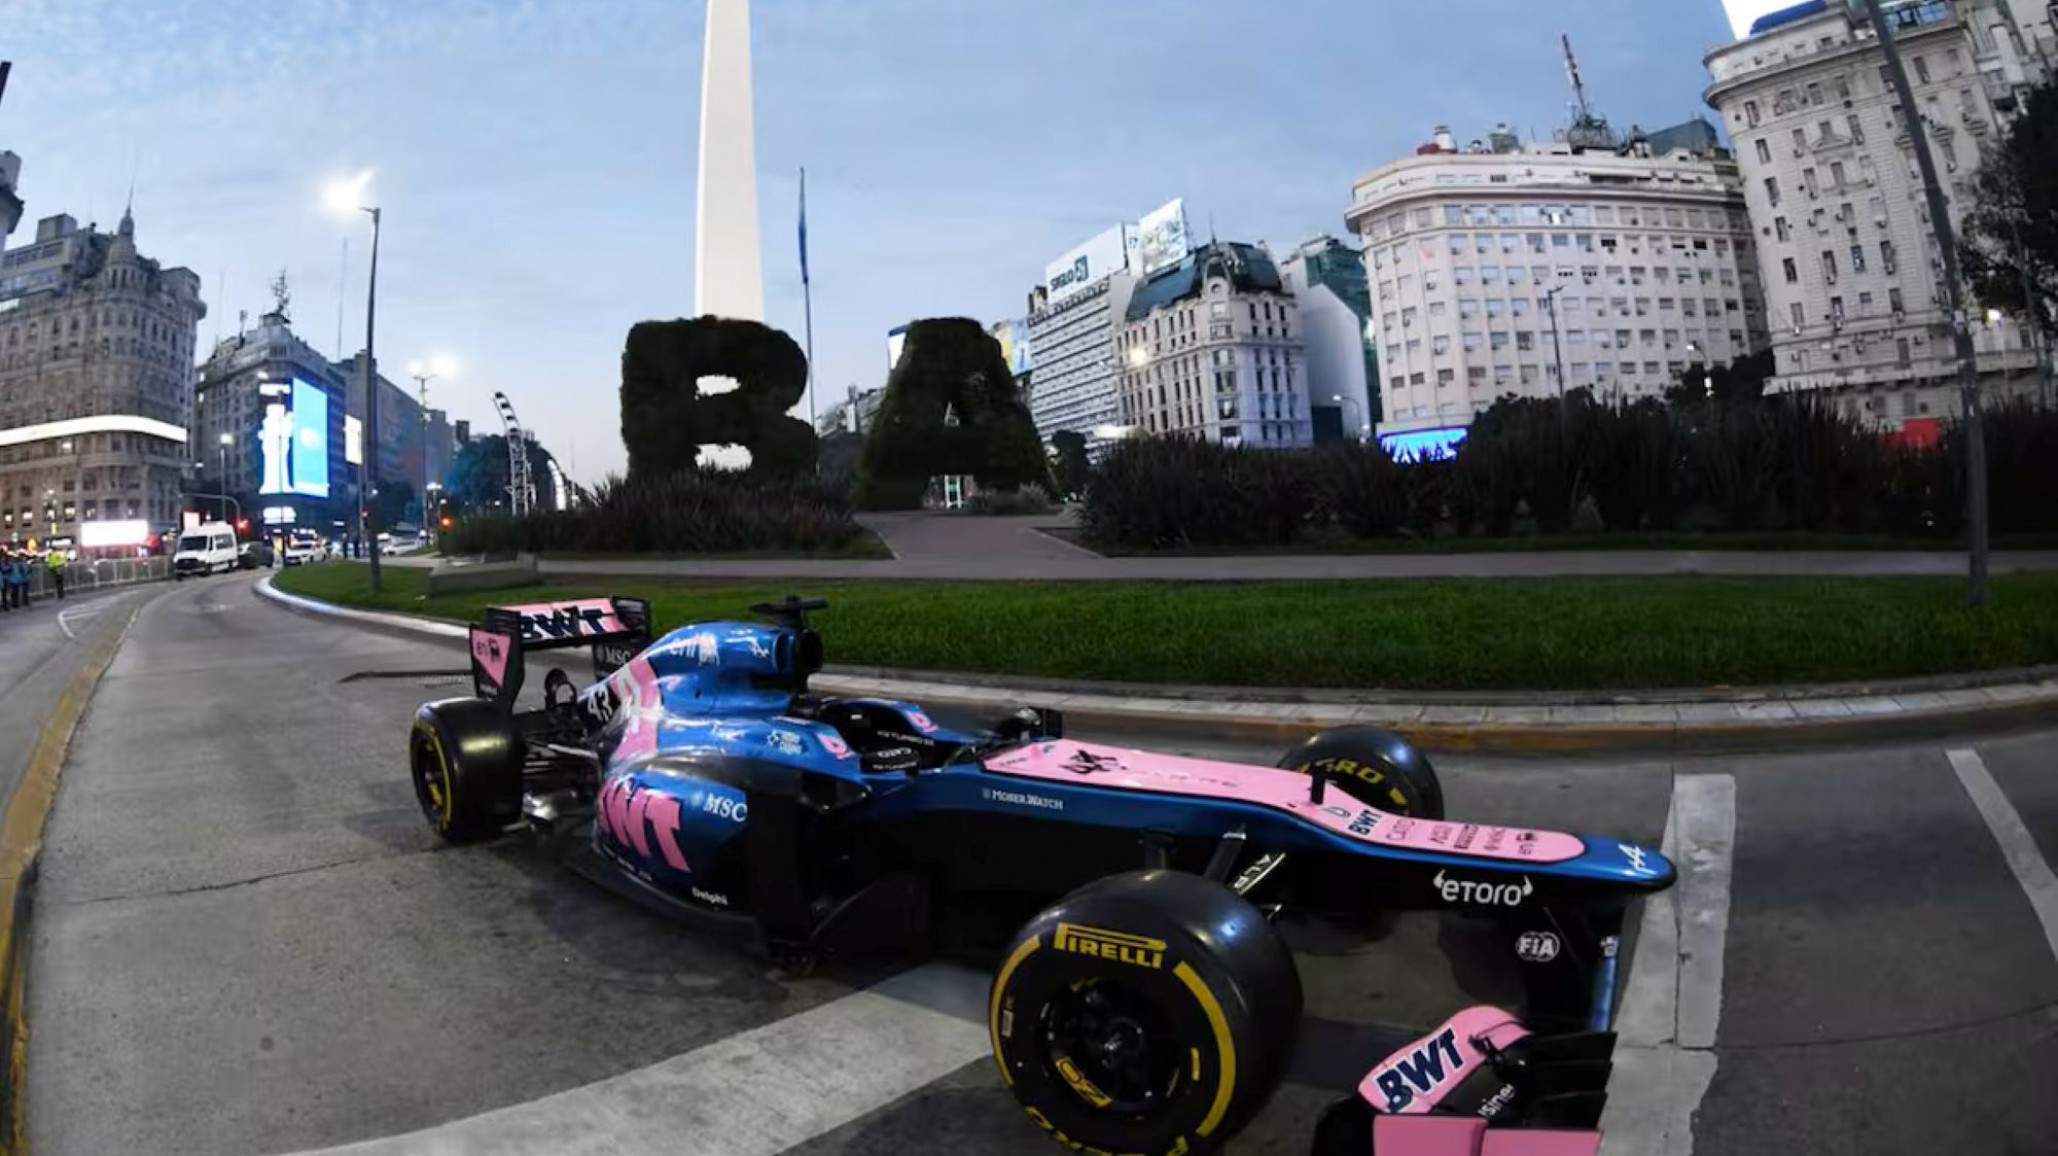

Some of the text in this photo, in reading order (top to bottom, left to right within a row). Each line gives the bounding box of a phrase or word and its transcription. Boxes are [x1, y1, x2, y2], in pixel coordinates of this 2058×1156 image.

[703, 793, 748, 822] MSC
[1026, 794, 1064, 811] WATCH
[1348, 808, 1382, 836] BWT
[1054, 922, 1167, 969] PIRELLI
[1376, 1028, 1464, 1113] BWT
